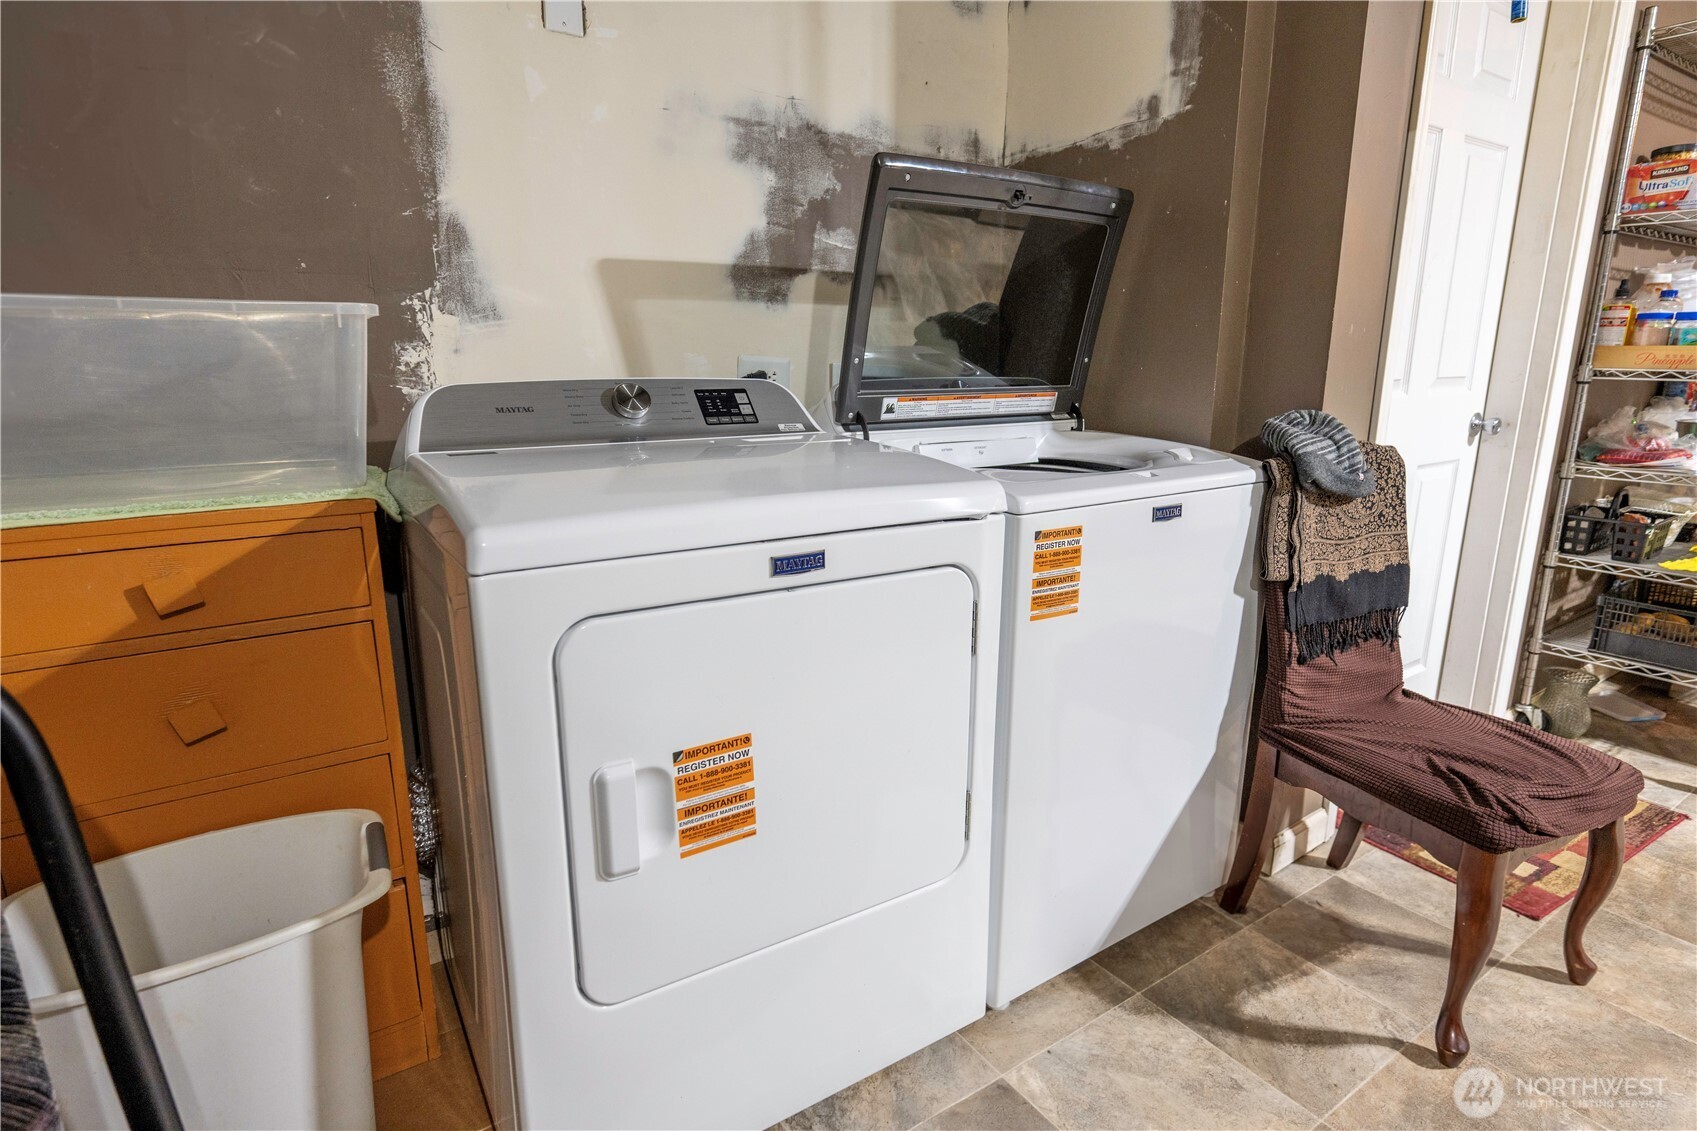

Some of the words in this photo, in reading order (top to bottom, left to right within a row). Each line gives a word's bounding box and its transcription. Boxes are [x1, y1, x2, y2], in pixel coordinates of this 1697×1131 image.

[1652, 165, 1689, 176] KIRKLAND
[495, 406, 534, 414] MAYTAG
[1155, 507, 1181, 518] MAYTAG
[1041, 528, 1077, 539] IMPORTANT!
[1036, 541, 1066, 551] REGISTER
[1067, 538, 1081, 546] NOW
[775, 554, 824, 572] MAYTAG
[1036, 575, 1076, 587] IMPORTANTE!
[685, 738, 743, 759] IMPORTANT!
[677, 757, 726, 775] REGISTER
[728, 749, 751, 761] NOW
[677, 774, 698, 786] CALL
[699, 760, 752, 780] 1-888-900-3381
[684, 793, 748, 818] IMPORTANTE!
[679, 809, 719, 828] ENREGISTREZ
[719, 801, 755, 814] MAINTENANT
[681, 823, 707, 835] APPELEZ
